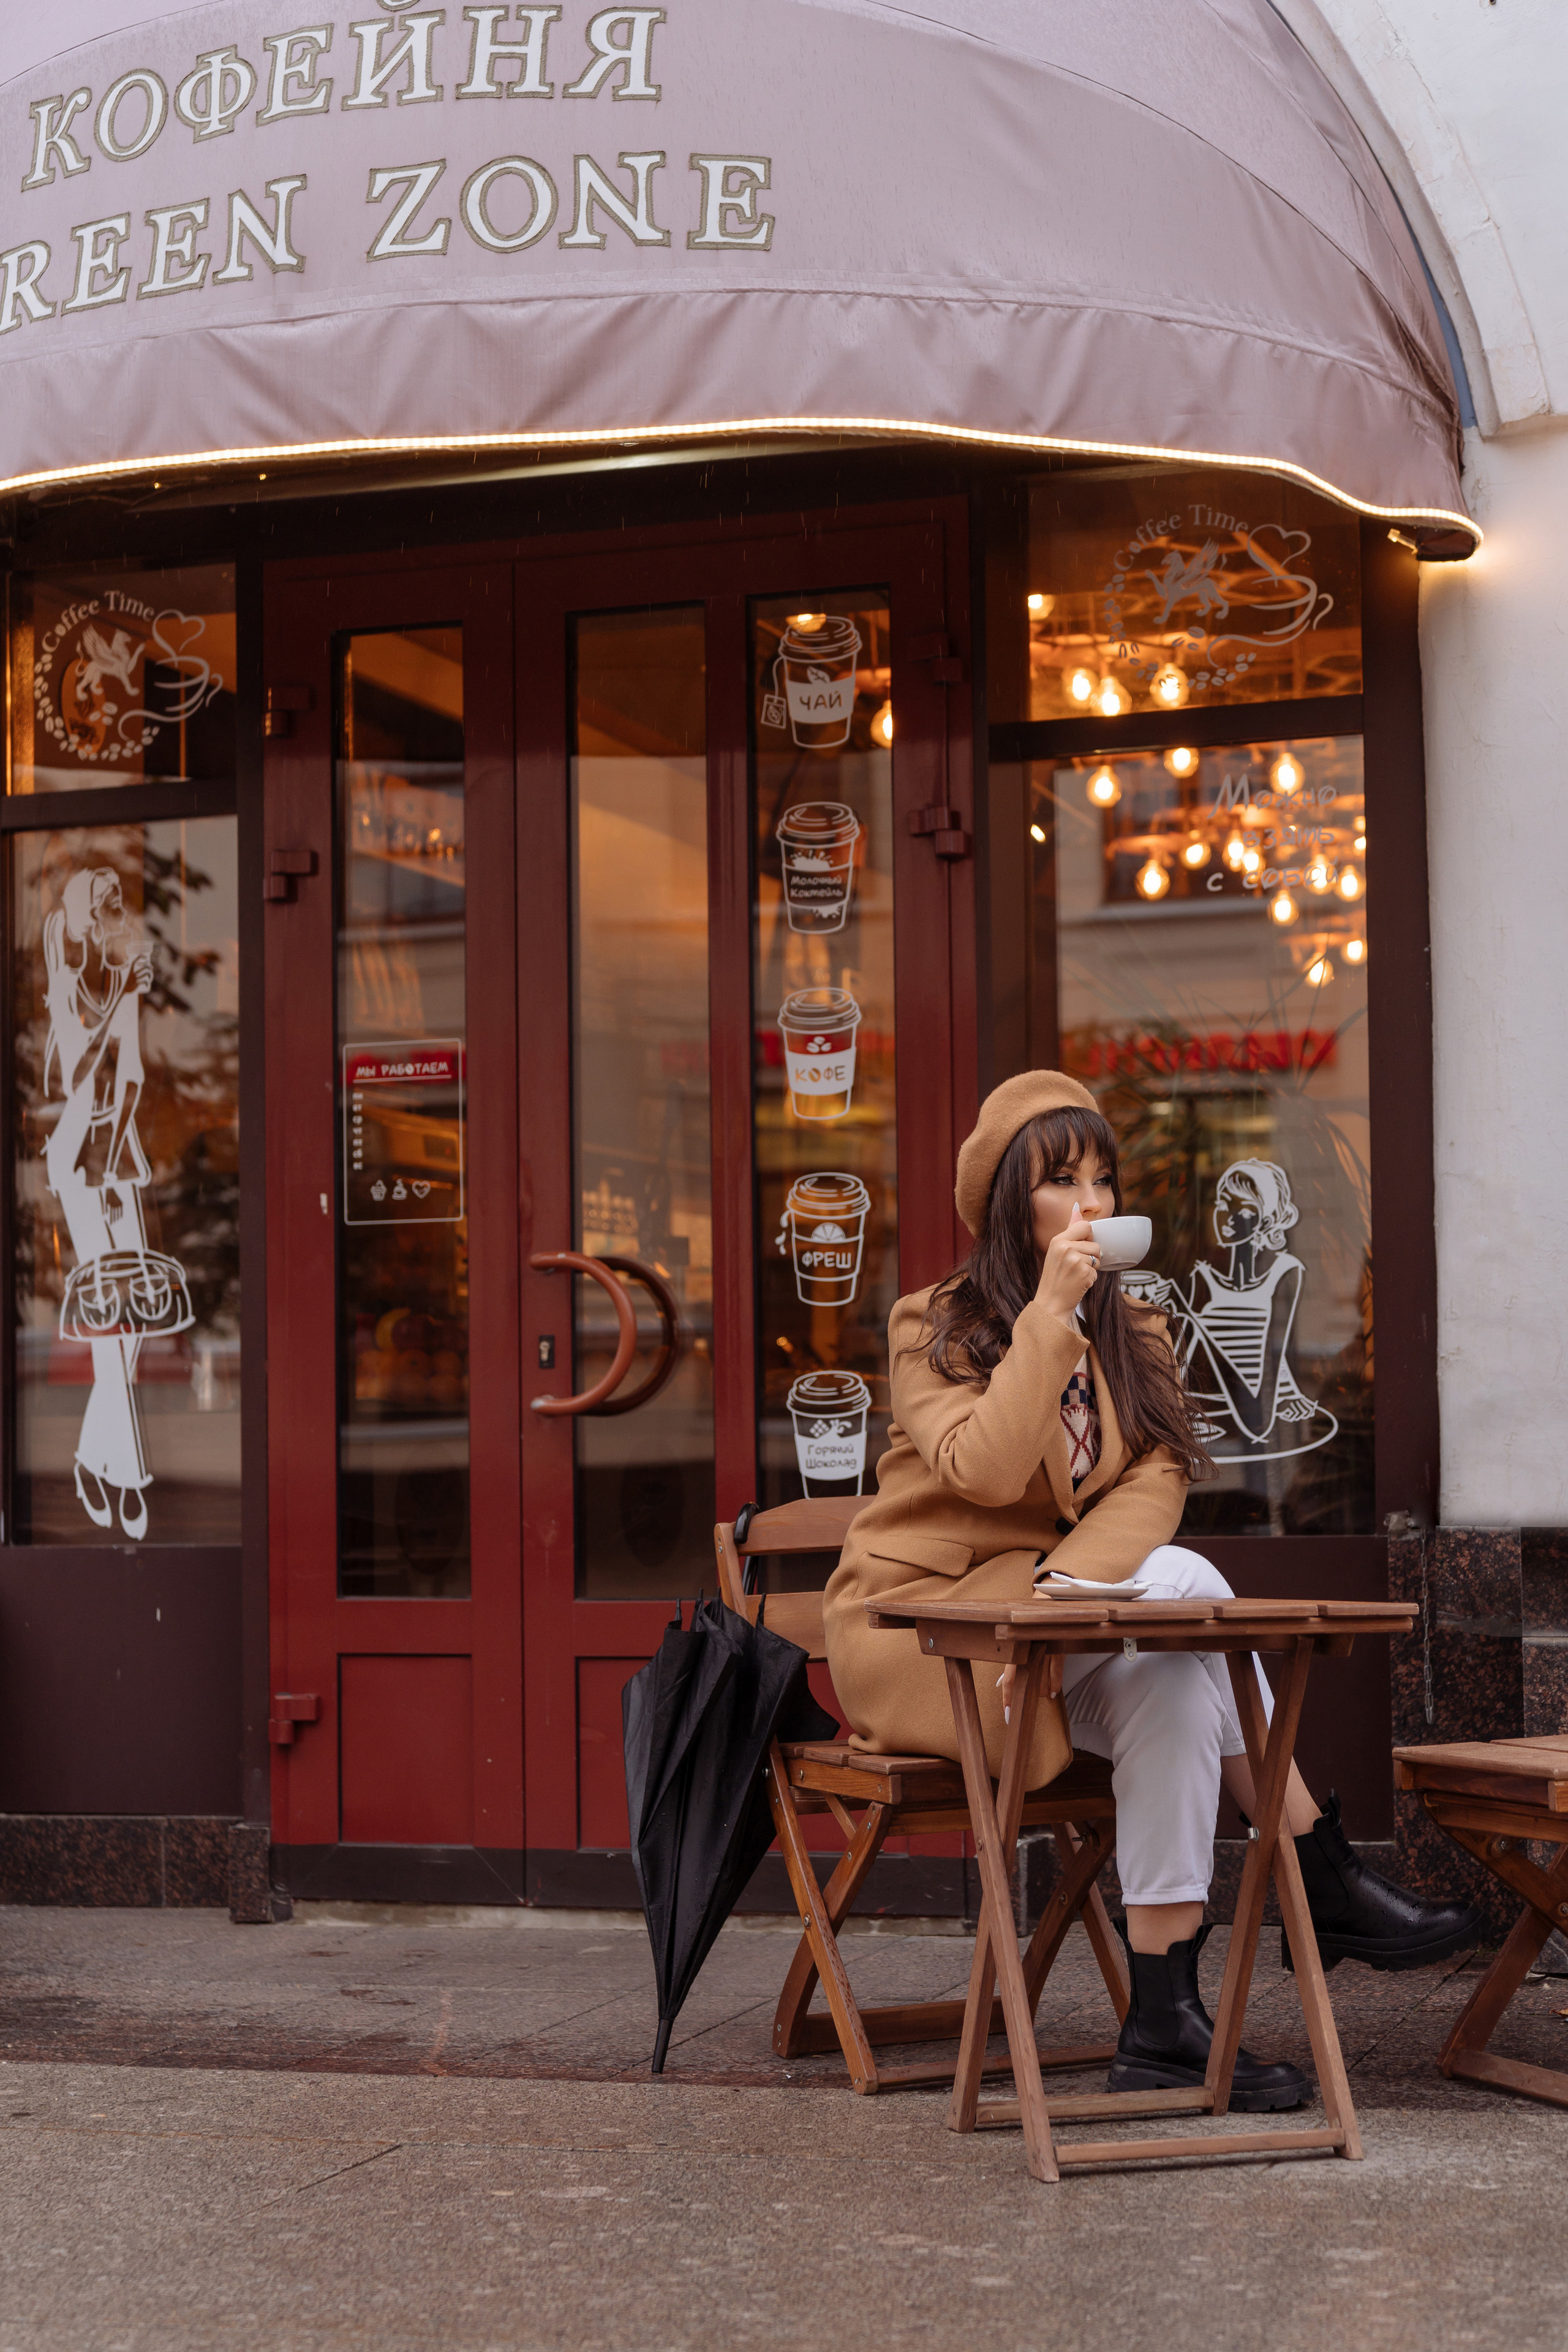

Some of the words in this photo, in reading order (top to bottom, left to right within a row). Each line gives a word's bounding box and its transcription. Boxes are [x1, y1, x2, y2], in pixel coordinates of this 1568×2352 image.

[21, 0, 666, 192] КОФЕЙНЯ
[367, 151, 775, 262] ZONE
[1114, 514, 1182, 571] Coffee
[1188, 504, 1248, 537] Time
[42, 599, 100, 652] Coffee
[104, 590, 154, 622] Time
[799, 690, 842, 710] ЧАЙ
[1207, 774, 1336, 819] Можно
[356, 1065, 376, 1077] МЫ
[381, 1061, 448, 1077] РАБОТАЕМ
[795, 1065, 846, 1083] КОФЕ
[802, 1251, 851, 1268] ФРЕШ
[807, 1444, 854, 1457] Горячий
[805, 1458, 858, 1470] Шоколад
